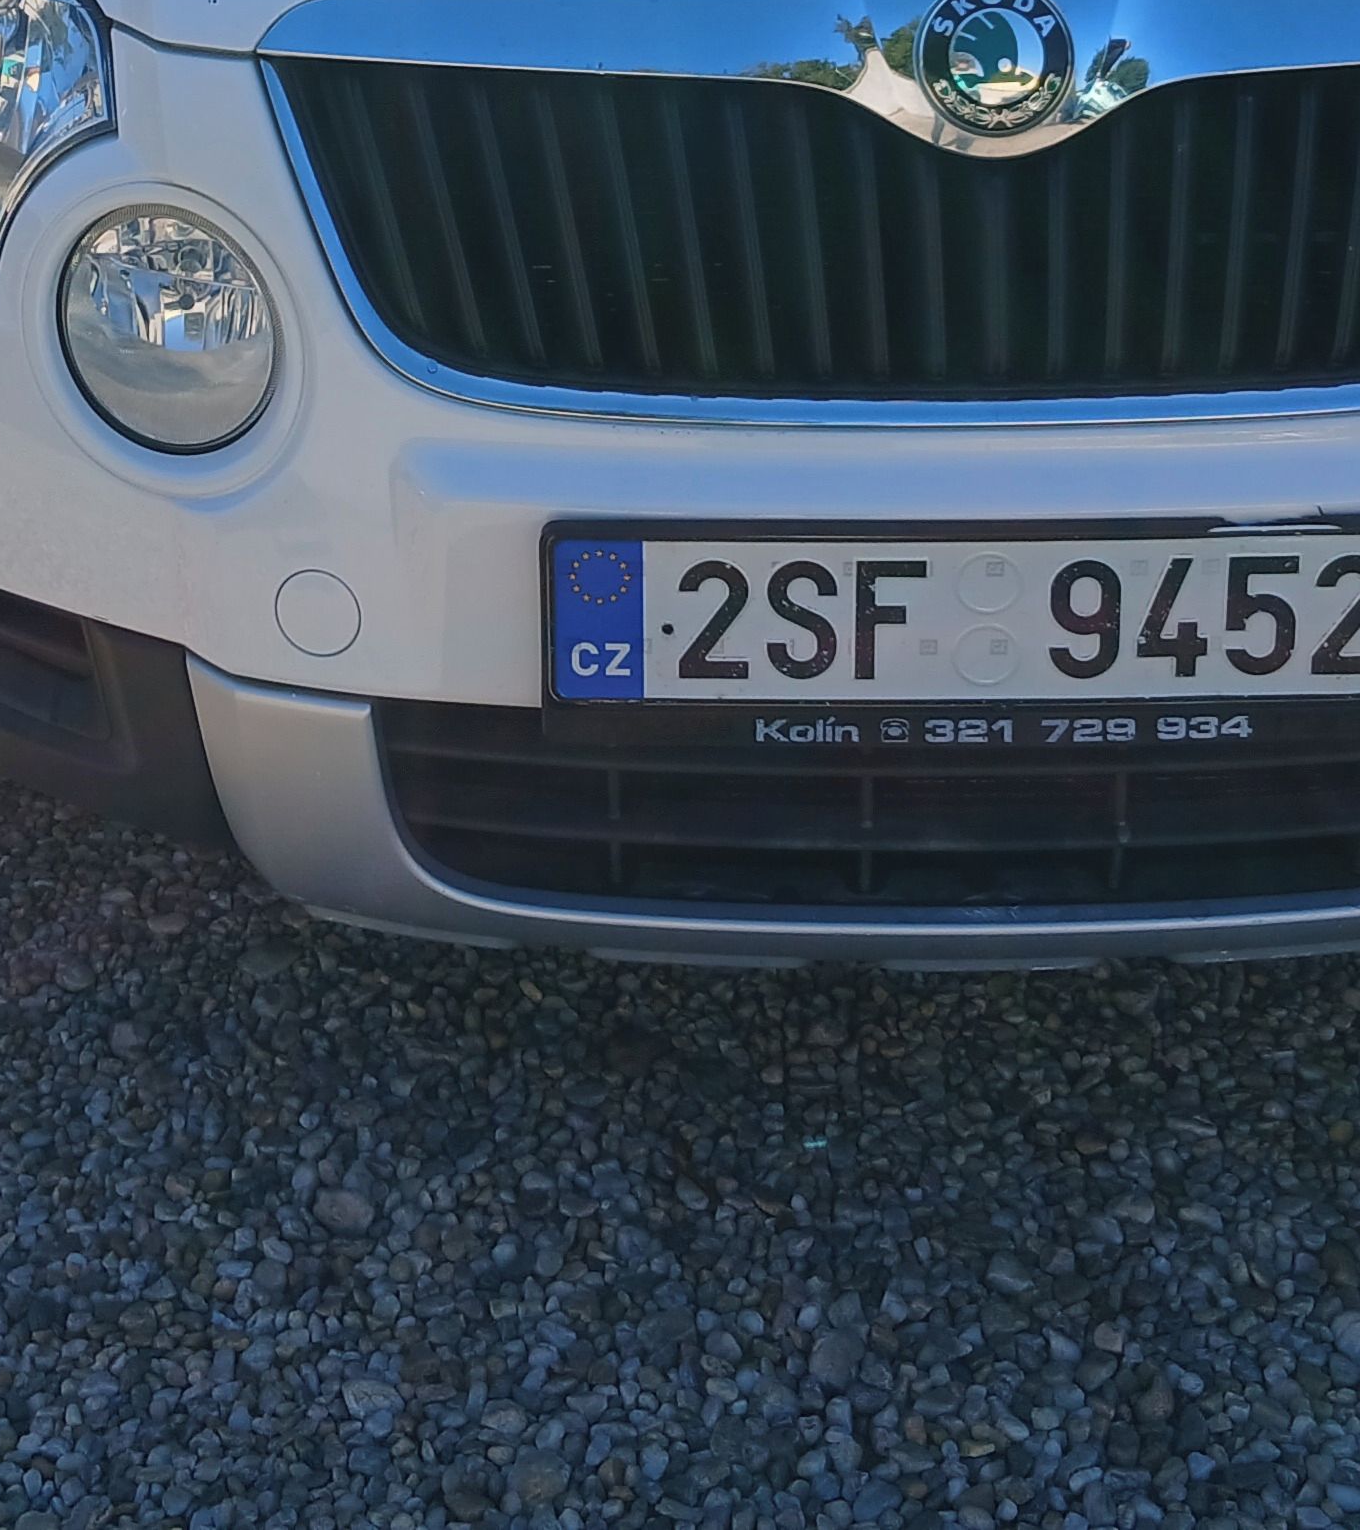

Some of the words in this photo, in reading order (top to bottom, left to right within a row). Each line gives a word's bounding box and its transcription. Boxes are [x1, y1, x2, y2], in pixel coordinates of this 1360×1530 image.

[678, 560, 928, 679] 2SF
[570, 642, 632, 677] CZ
[753, 715, 860, 743] Kolín
[923, 718, 1013, 743] 321
[1040, 717, 1136, 743] 729
[1156, 715, 1253, 740] 934
